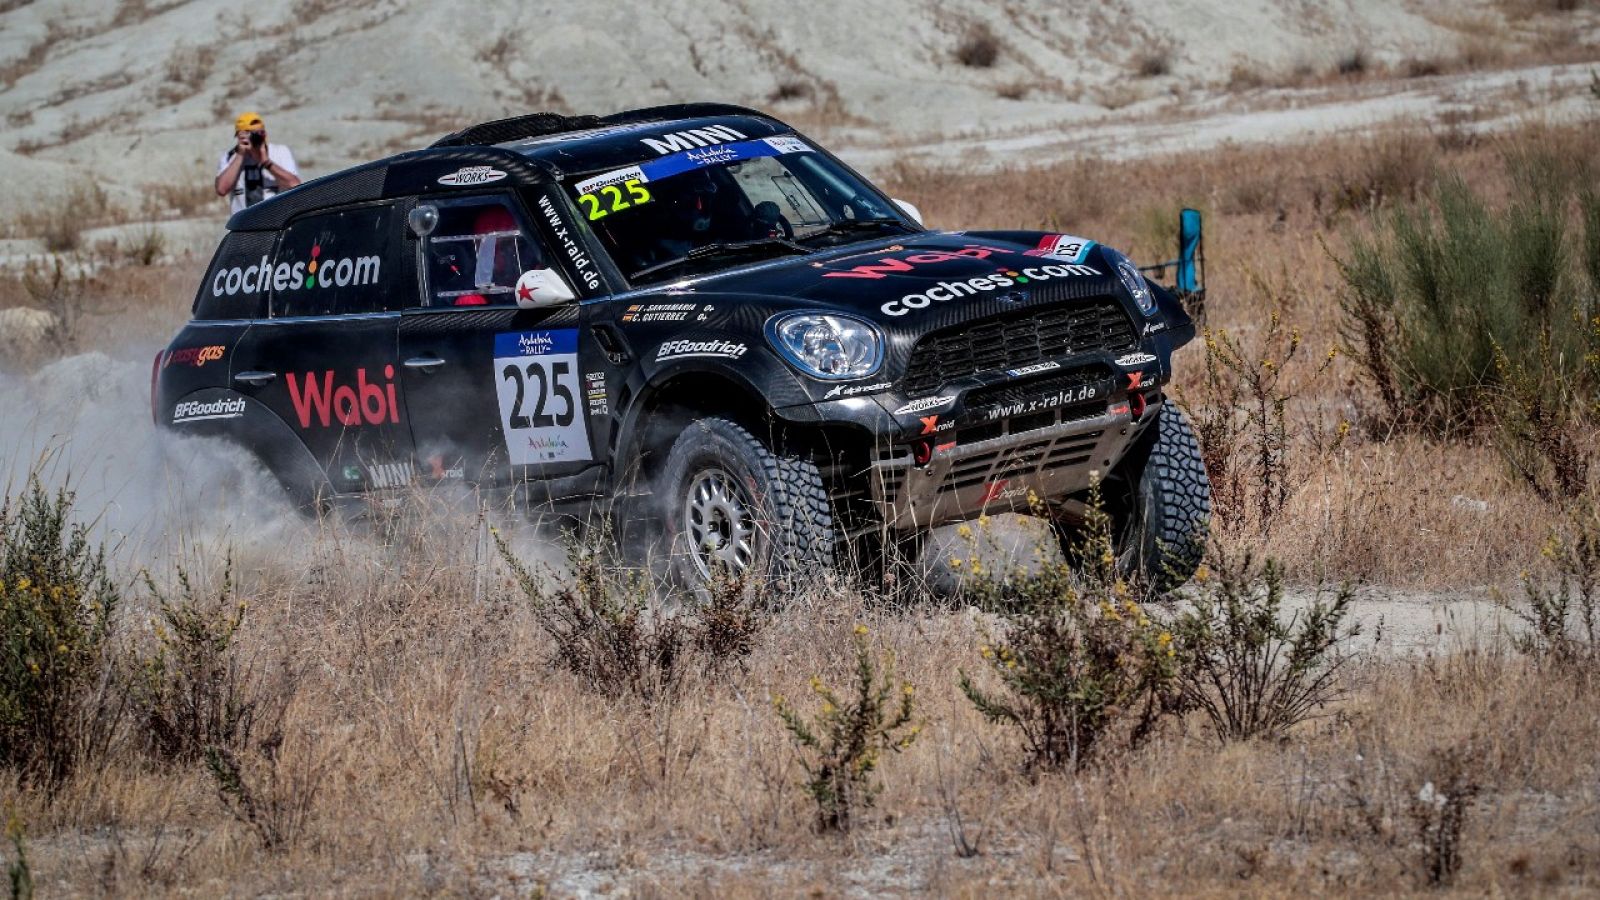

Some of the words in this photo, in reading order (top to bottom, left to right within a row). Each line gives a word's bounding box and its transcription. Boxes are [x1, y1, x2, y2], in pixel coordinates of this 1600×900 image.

[640, 124, 748, 155] MINI
[455, 171, 488, 184] WORKS
[579, 178, 651, 221] 225
[538, 194, 600, 290] www.x-raid.de
[822, 244, 1014, 280] Wabi
[656, 340, 748, 358] BFGoodrich
[173, 398, 247, 419] BFGoodrich
[285, 364, 400, 429] Wabi
[503, 362, 575, 430] 225
[988, 386, 1096, 420] www.x-raid.de
[368, 461, 412, 488] MINI
